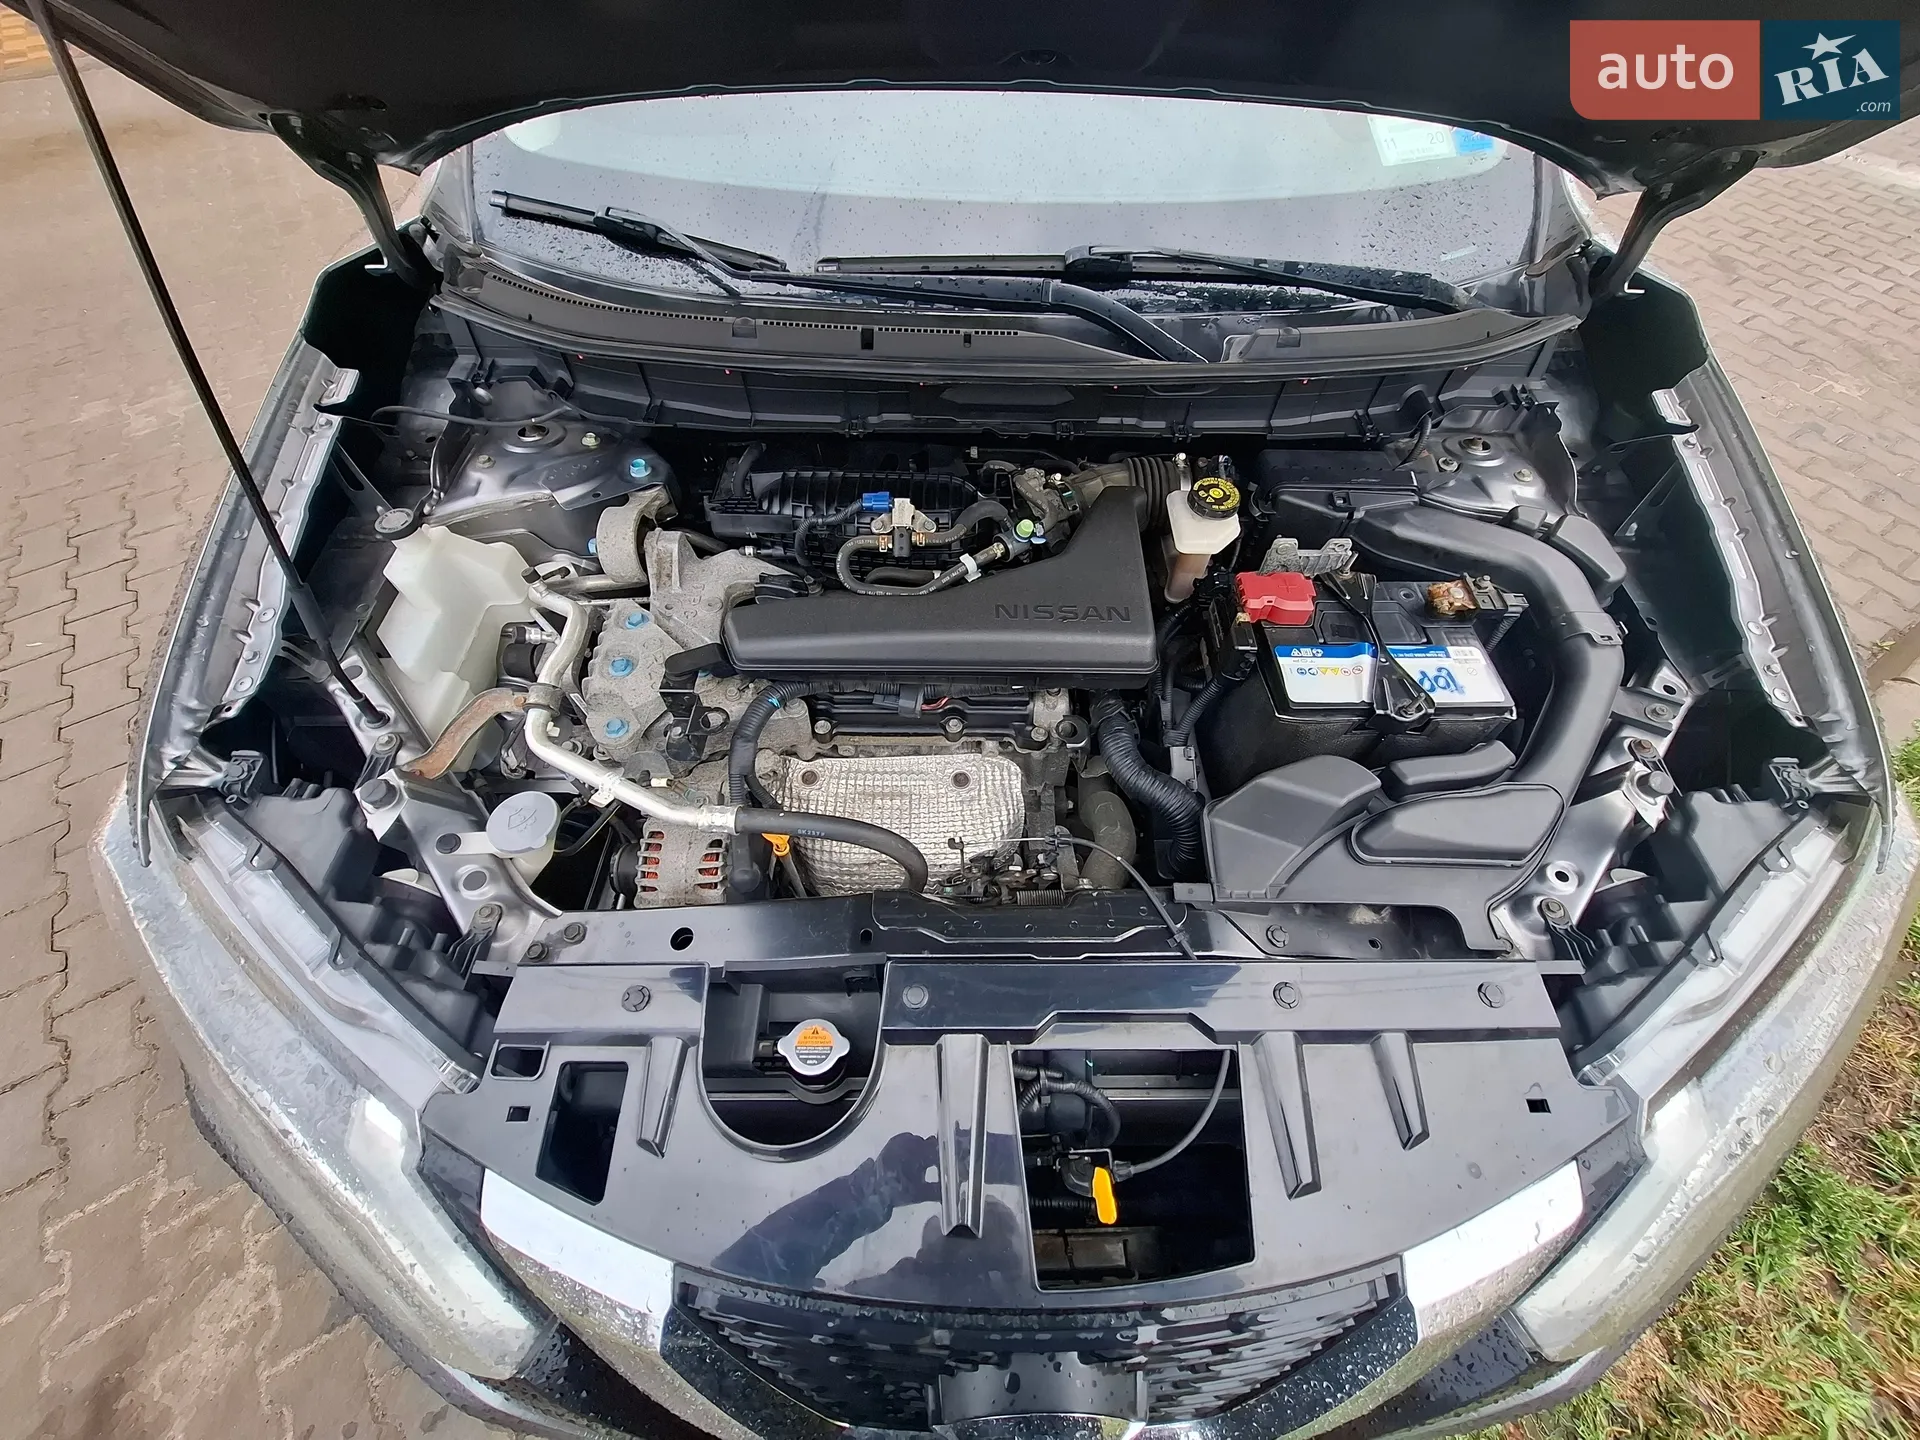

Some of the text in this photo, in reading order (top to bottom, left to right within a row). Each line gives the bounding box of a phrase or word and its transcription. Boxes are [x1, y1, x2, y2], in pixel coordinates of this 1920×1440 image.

[1384, 131, 1445, 151] 11 20
[994, 603, 1132, 623] NISSAN
